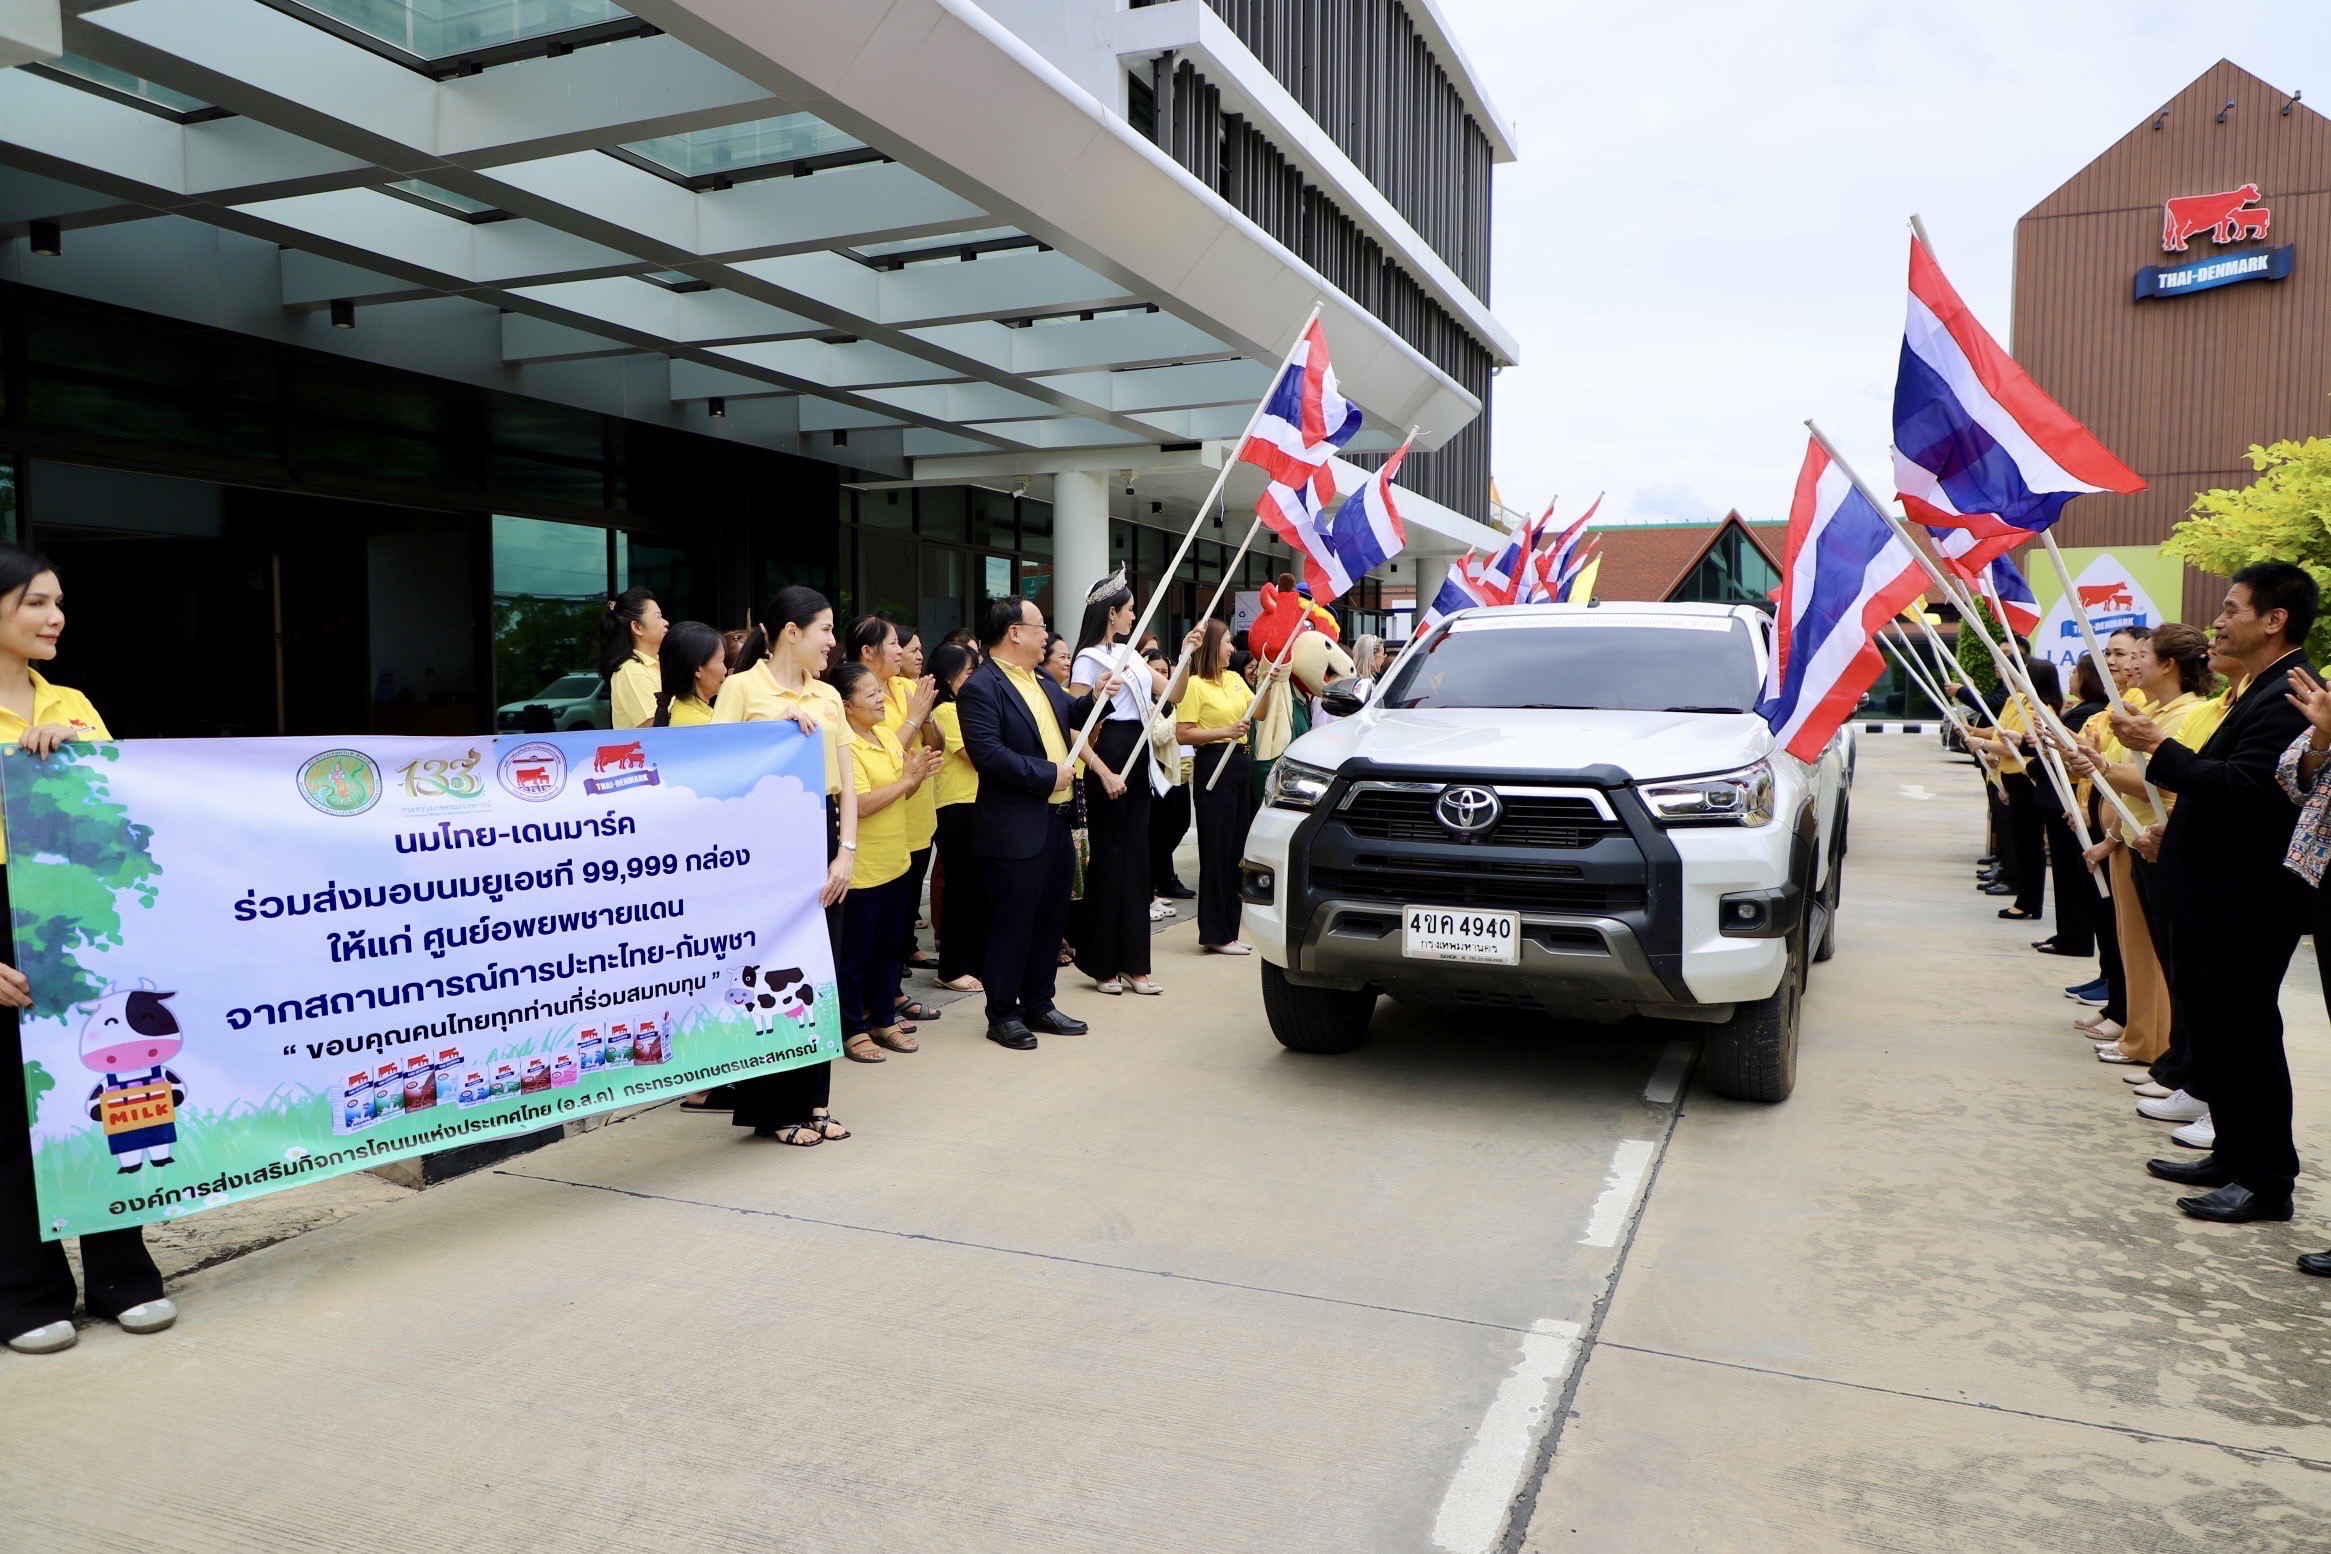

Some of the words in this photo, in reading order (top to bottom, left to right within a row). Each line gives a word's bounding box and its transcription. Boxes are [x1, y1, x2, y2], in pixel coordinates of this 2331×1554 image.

[2158, 254, 2269, 289] THAI-DENMARK
[2073, 616, 2134, 634] T-DENMARK
[595, 773, 649, 791] THAI-DENMARK
[395, 810, 636, 854] นมไทย-เดนมาร์ค
[234, 859, 574, 922] ร่วมส่งมอบนมยูเอชที
[582, 854, 678, 885] 99,999
[685, 844, 751, 872] กล่อง
[326, 924, 413, 963] ให้แก่
[423, 899, 684, 959] ศูนย์อพยพชายแดน
[1410, 913, 1454, 935] 4ขค
[1460, 916, 1511, 939] 4940
[1421, 940, 1498, 953] กรุงเทพมหานคร
[225, 930, 757, 1030] จากสถานการณ์การปะทะไทย-กัมพูชา
[306, 975, 706, 1060] ขอบคุณคนไทยทุกท่านที่ร่วมสมทบทุน
[109, 1102, 169, 1126] MILK
[109, 1104, 552, 1216] องค์การส่งเสริมกิจการโคนมแห่งประเทศไทย
[623, 1039, 819, 1097] กระทรวงเกษตรและสหกรณ์
